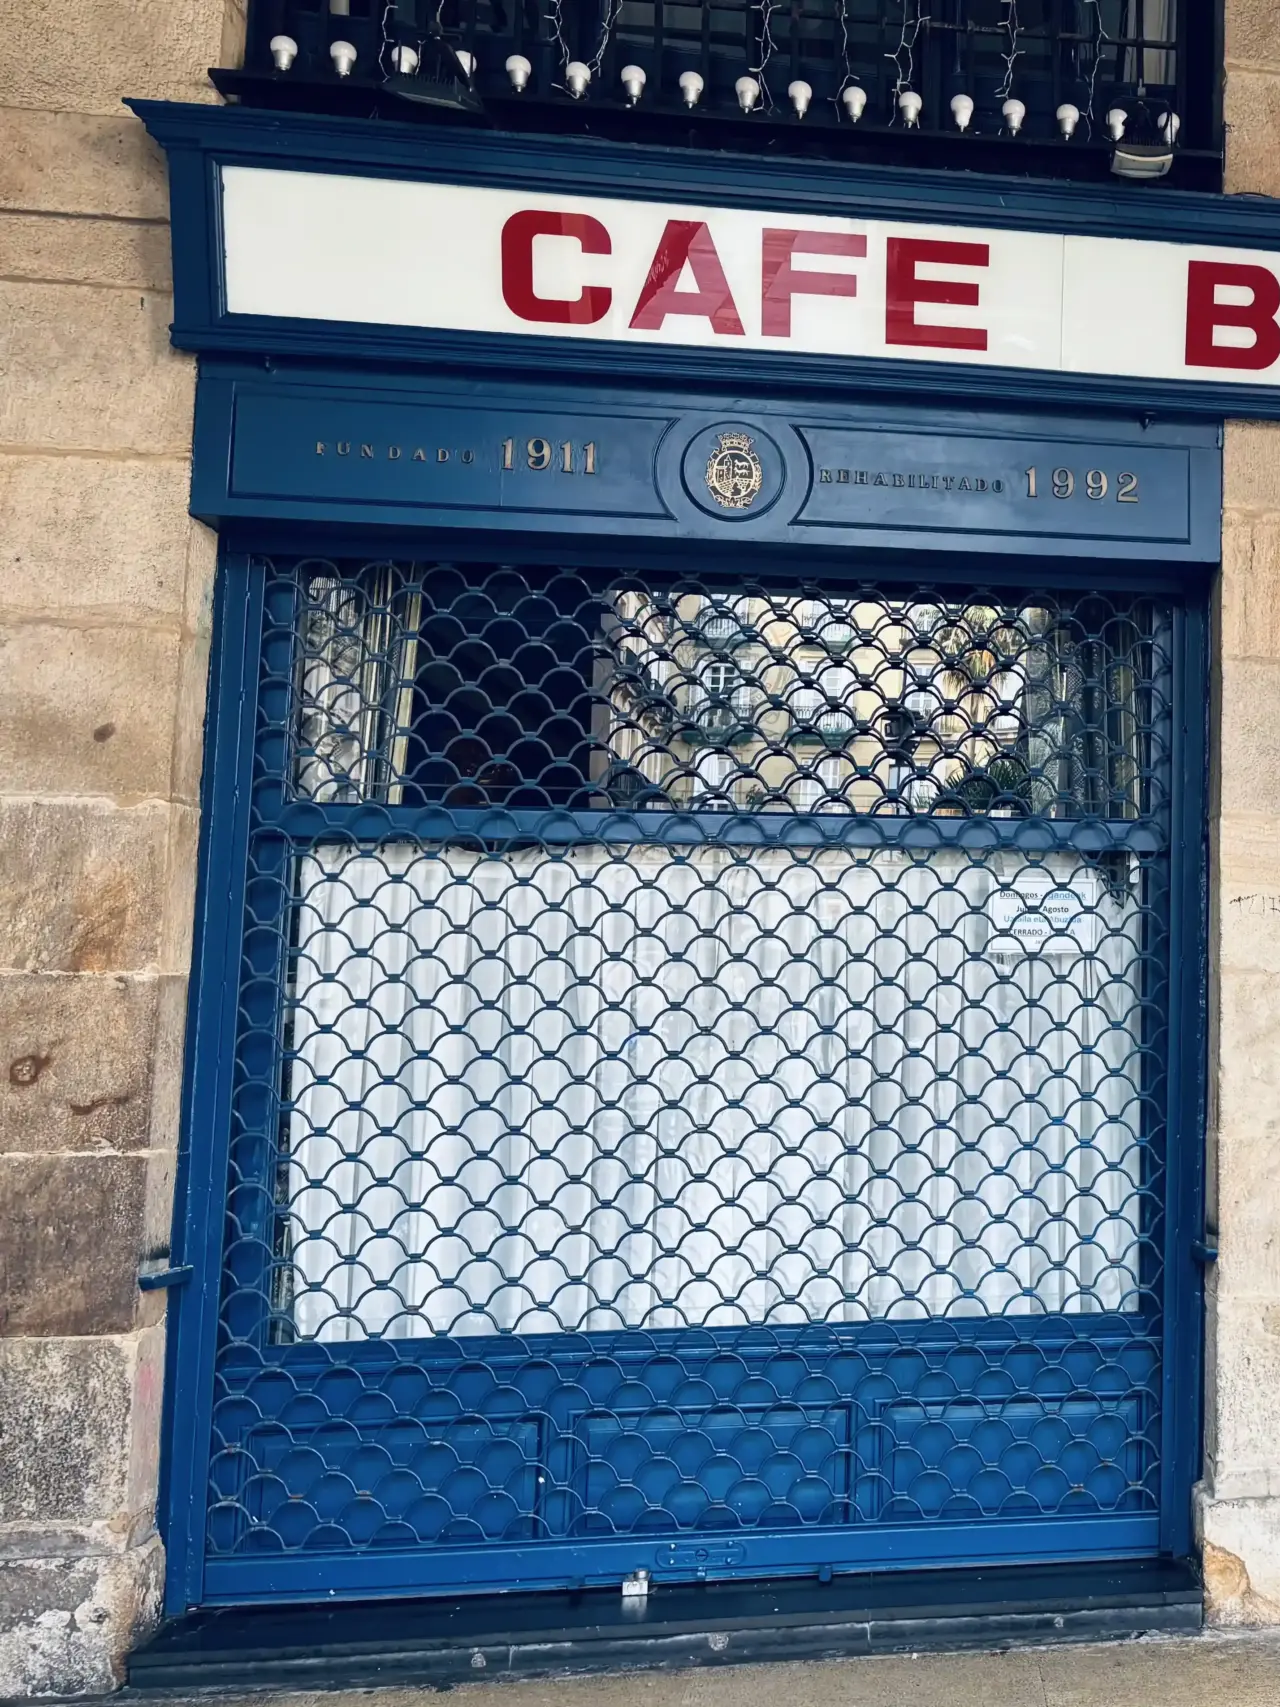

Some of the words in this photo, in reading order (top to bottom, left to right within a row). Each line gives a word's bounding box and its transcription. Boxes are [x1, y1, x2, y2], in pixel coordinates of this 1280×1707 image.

[500, 209, 990, 351] CAFE
[316, 441, 475, 464] FUNDADO
[501, 437, 596, 475] 1911
[819, 468, 1006, 493] REHABILITADO
[1025, 466, 1139, 503] 1992
[1000, 890, 1038, 899] Domigos
[1046, 891, 1086, 900] gandek
[1043, 905, 1069, 914] Agosto
[1049, 915, 1081, 923] Abuza
[1009, 928, 1042, 936] ERRADO
